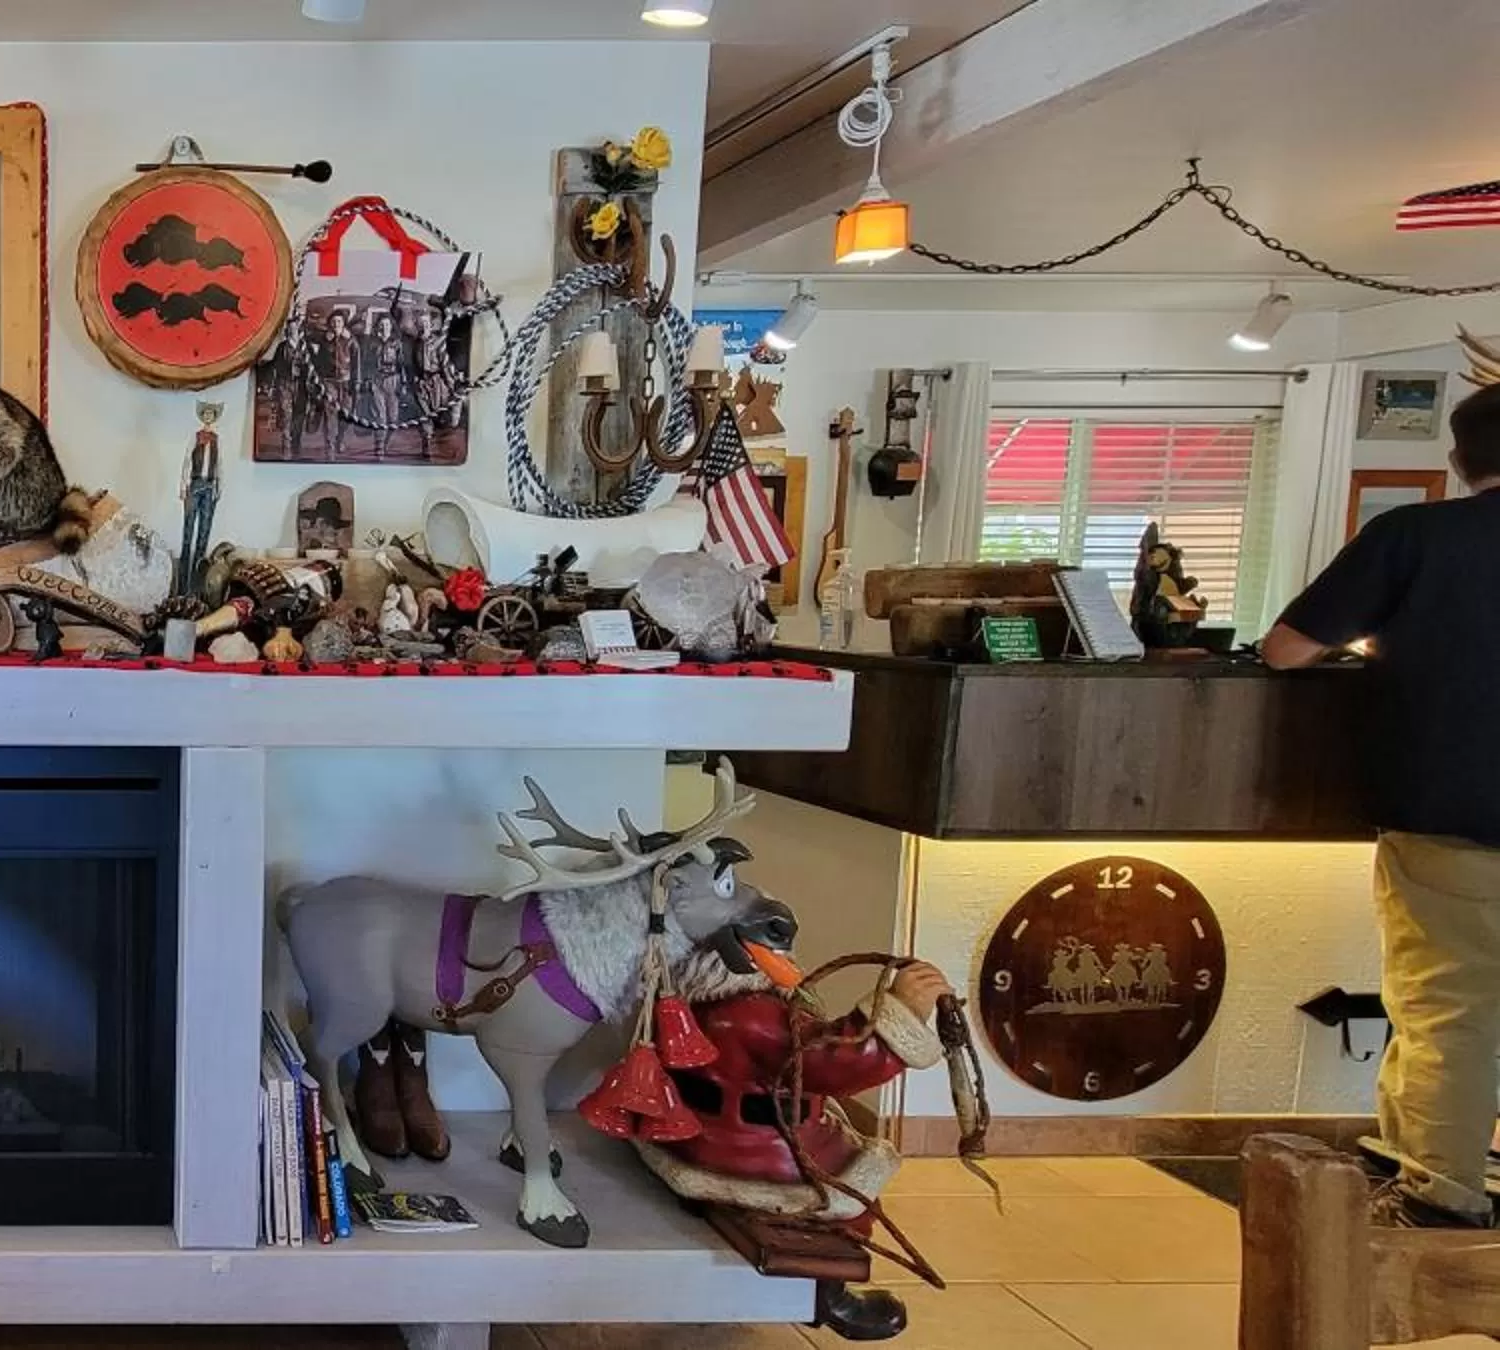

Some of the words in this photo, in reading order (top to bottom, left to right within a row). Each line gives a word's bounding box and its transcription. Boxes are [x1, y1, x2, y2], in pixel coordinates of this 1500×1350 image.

[1096, 865, 1134, 889] 12
[994, 970, 1013, 992] 9
[1193, 969, 1212, 991] 3
[1083, 1071, 1101, 1093] 6
